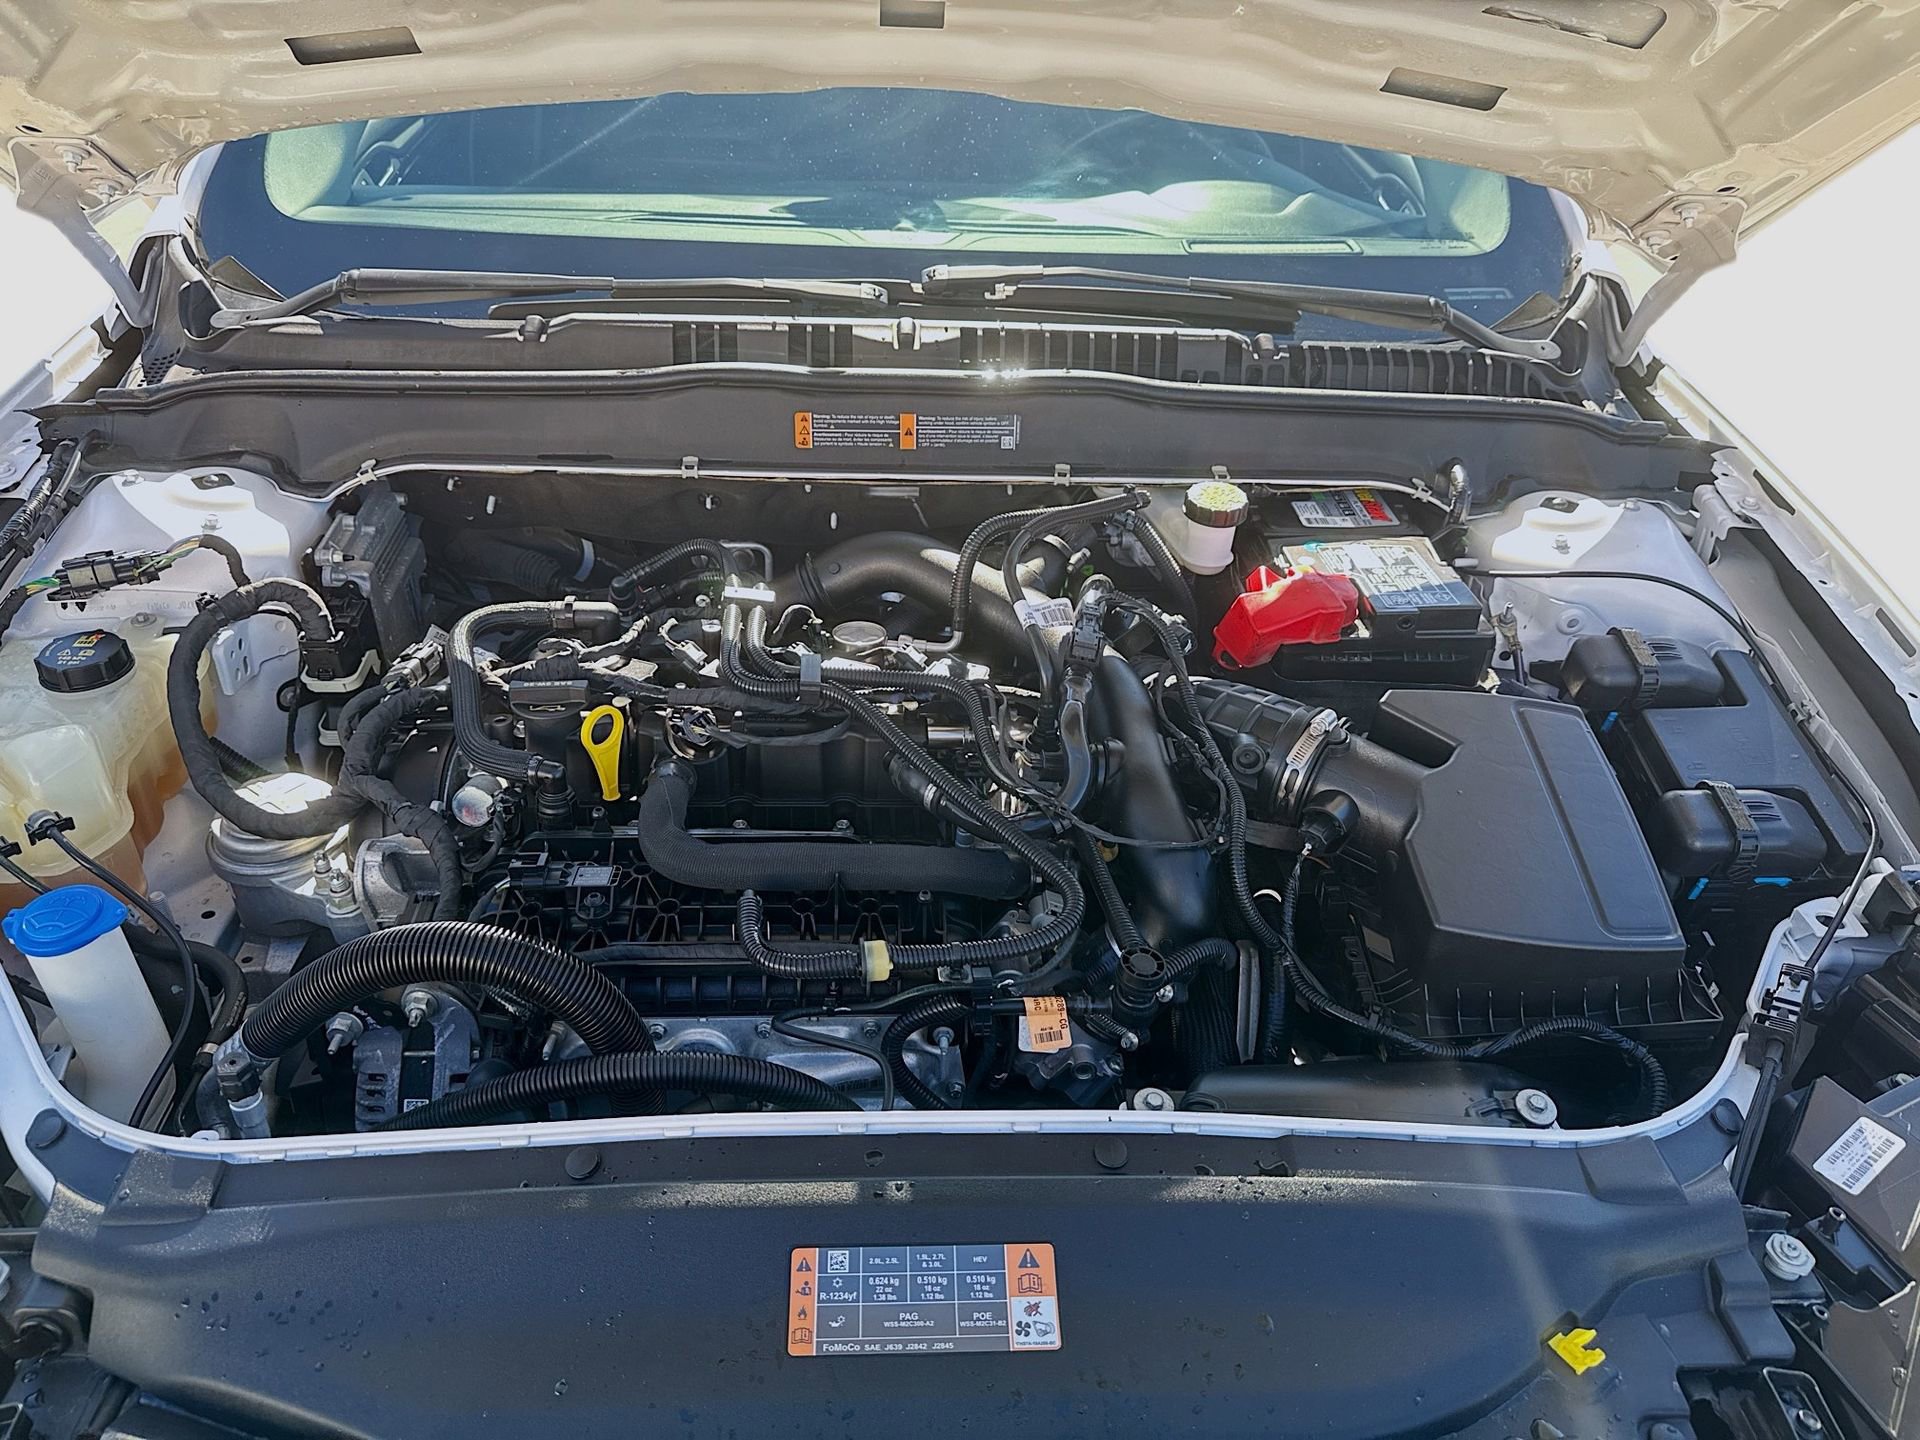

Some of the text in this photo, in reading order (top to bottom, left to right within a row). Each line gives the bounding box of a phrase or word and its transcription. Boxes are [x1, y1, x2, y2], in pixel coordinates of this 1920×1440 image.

[868, 1277, 900, 1286] 0.624 kg
[916, 1276, 948, 1286] 0.510 kg
[966, 1274, 996, 1284] 0.510 kg
[820, 1292, 857, 1302] R-1234yf
[899, 1312, 919, 1321] PAG
[973, 1312, 992, 1320] POE
[822, 1342, 861, 1352] FoMoCo
[864, 1344, 881, 1352] SAE
